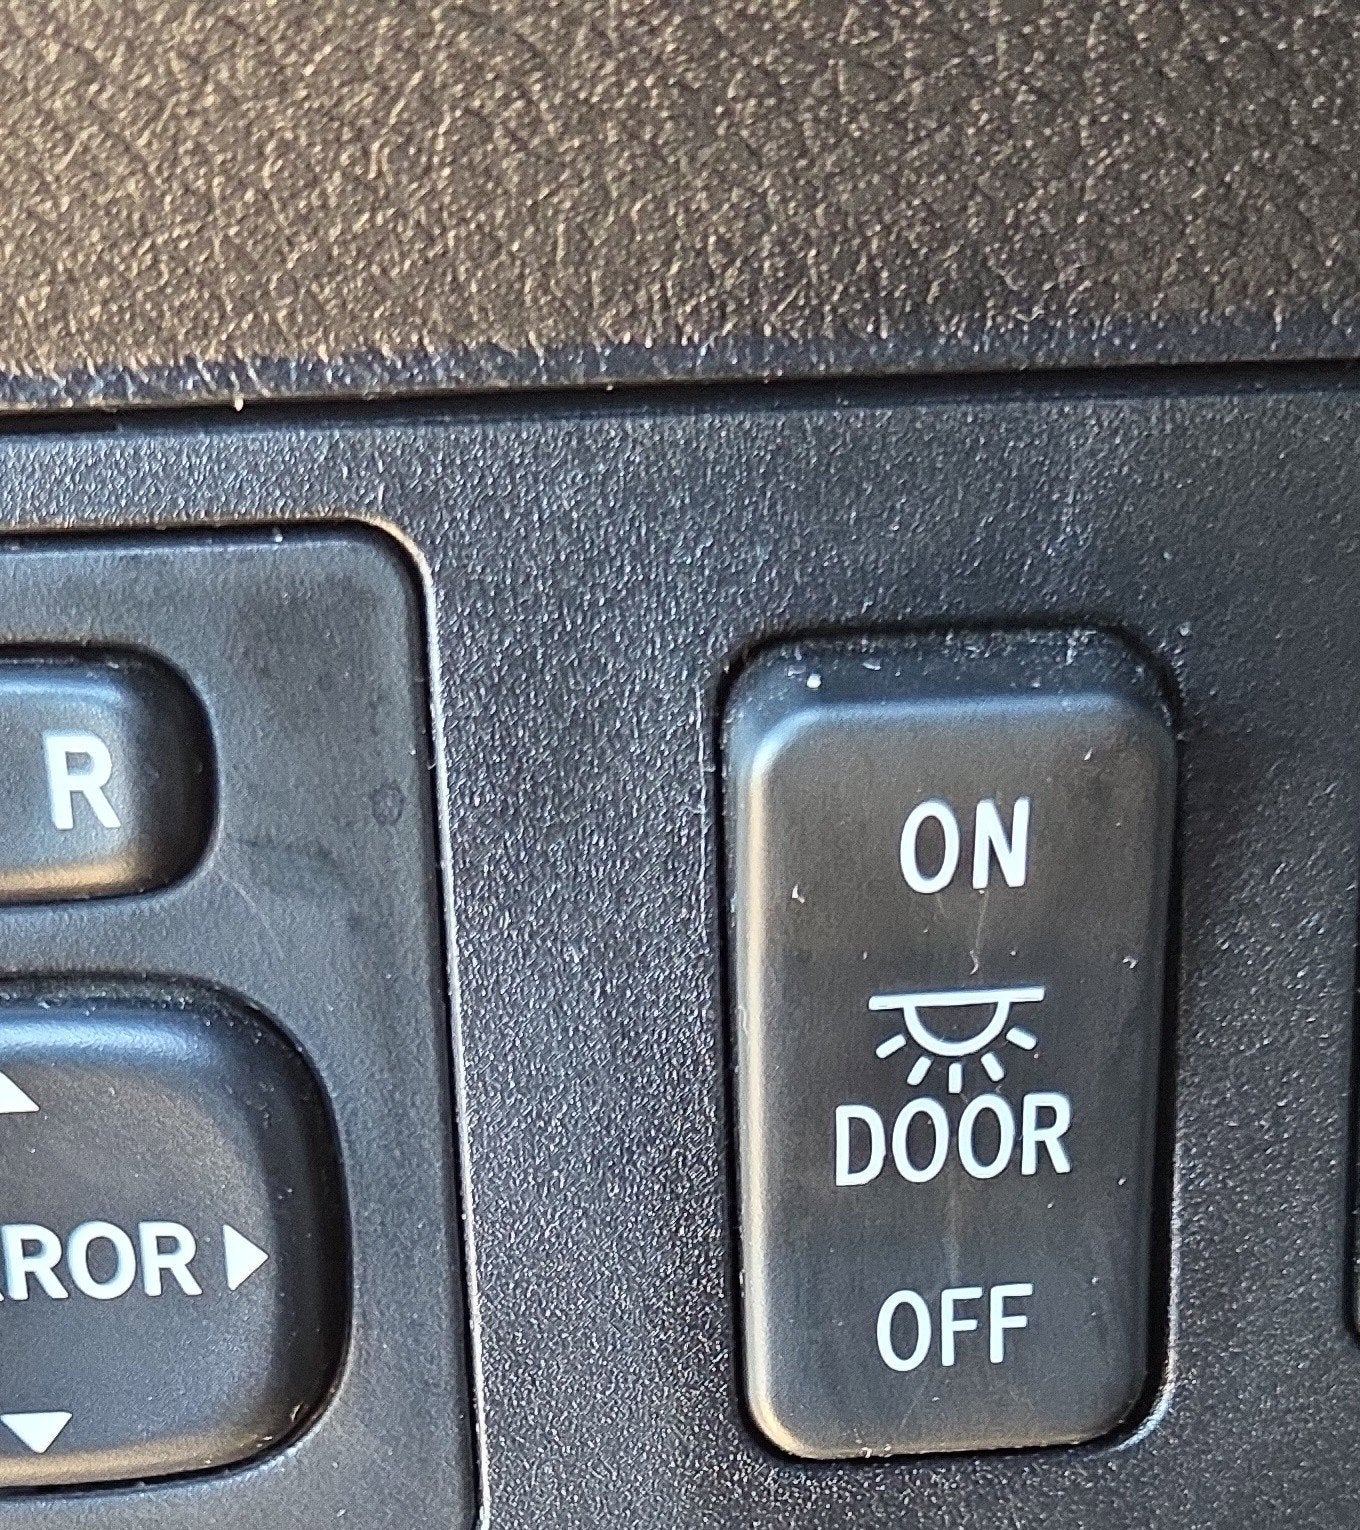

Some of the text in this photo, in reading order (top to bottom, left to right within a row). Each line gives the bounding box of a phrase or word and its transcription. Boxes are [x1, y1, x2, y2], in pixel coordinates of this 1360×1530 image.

[42, 729, 122, 831] R
[899, 796, 1032, 895] ON
[834, 1091, 1073, 1188] DOOR
[875, 1283, 1035, 1373] OFF
